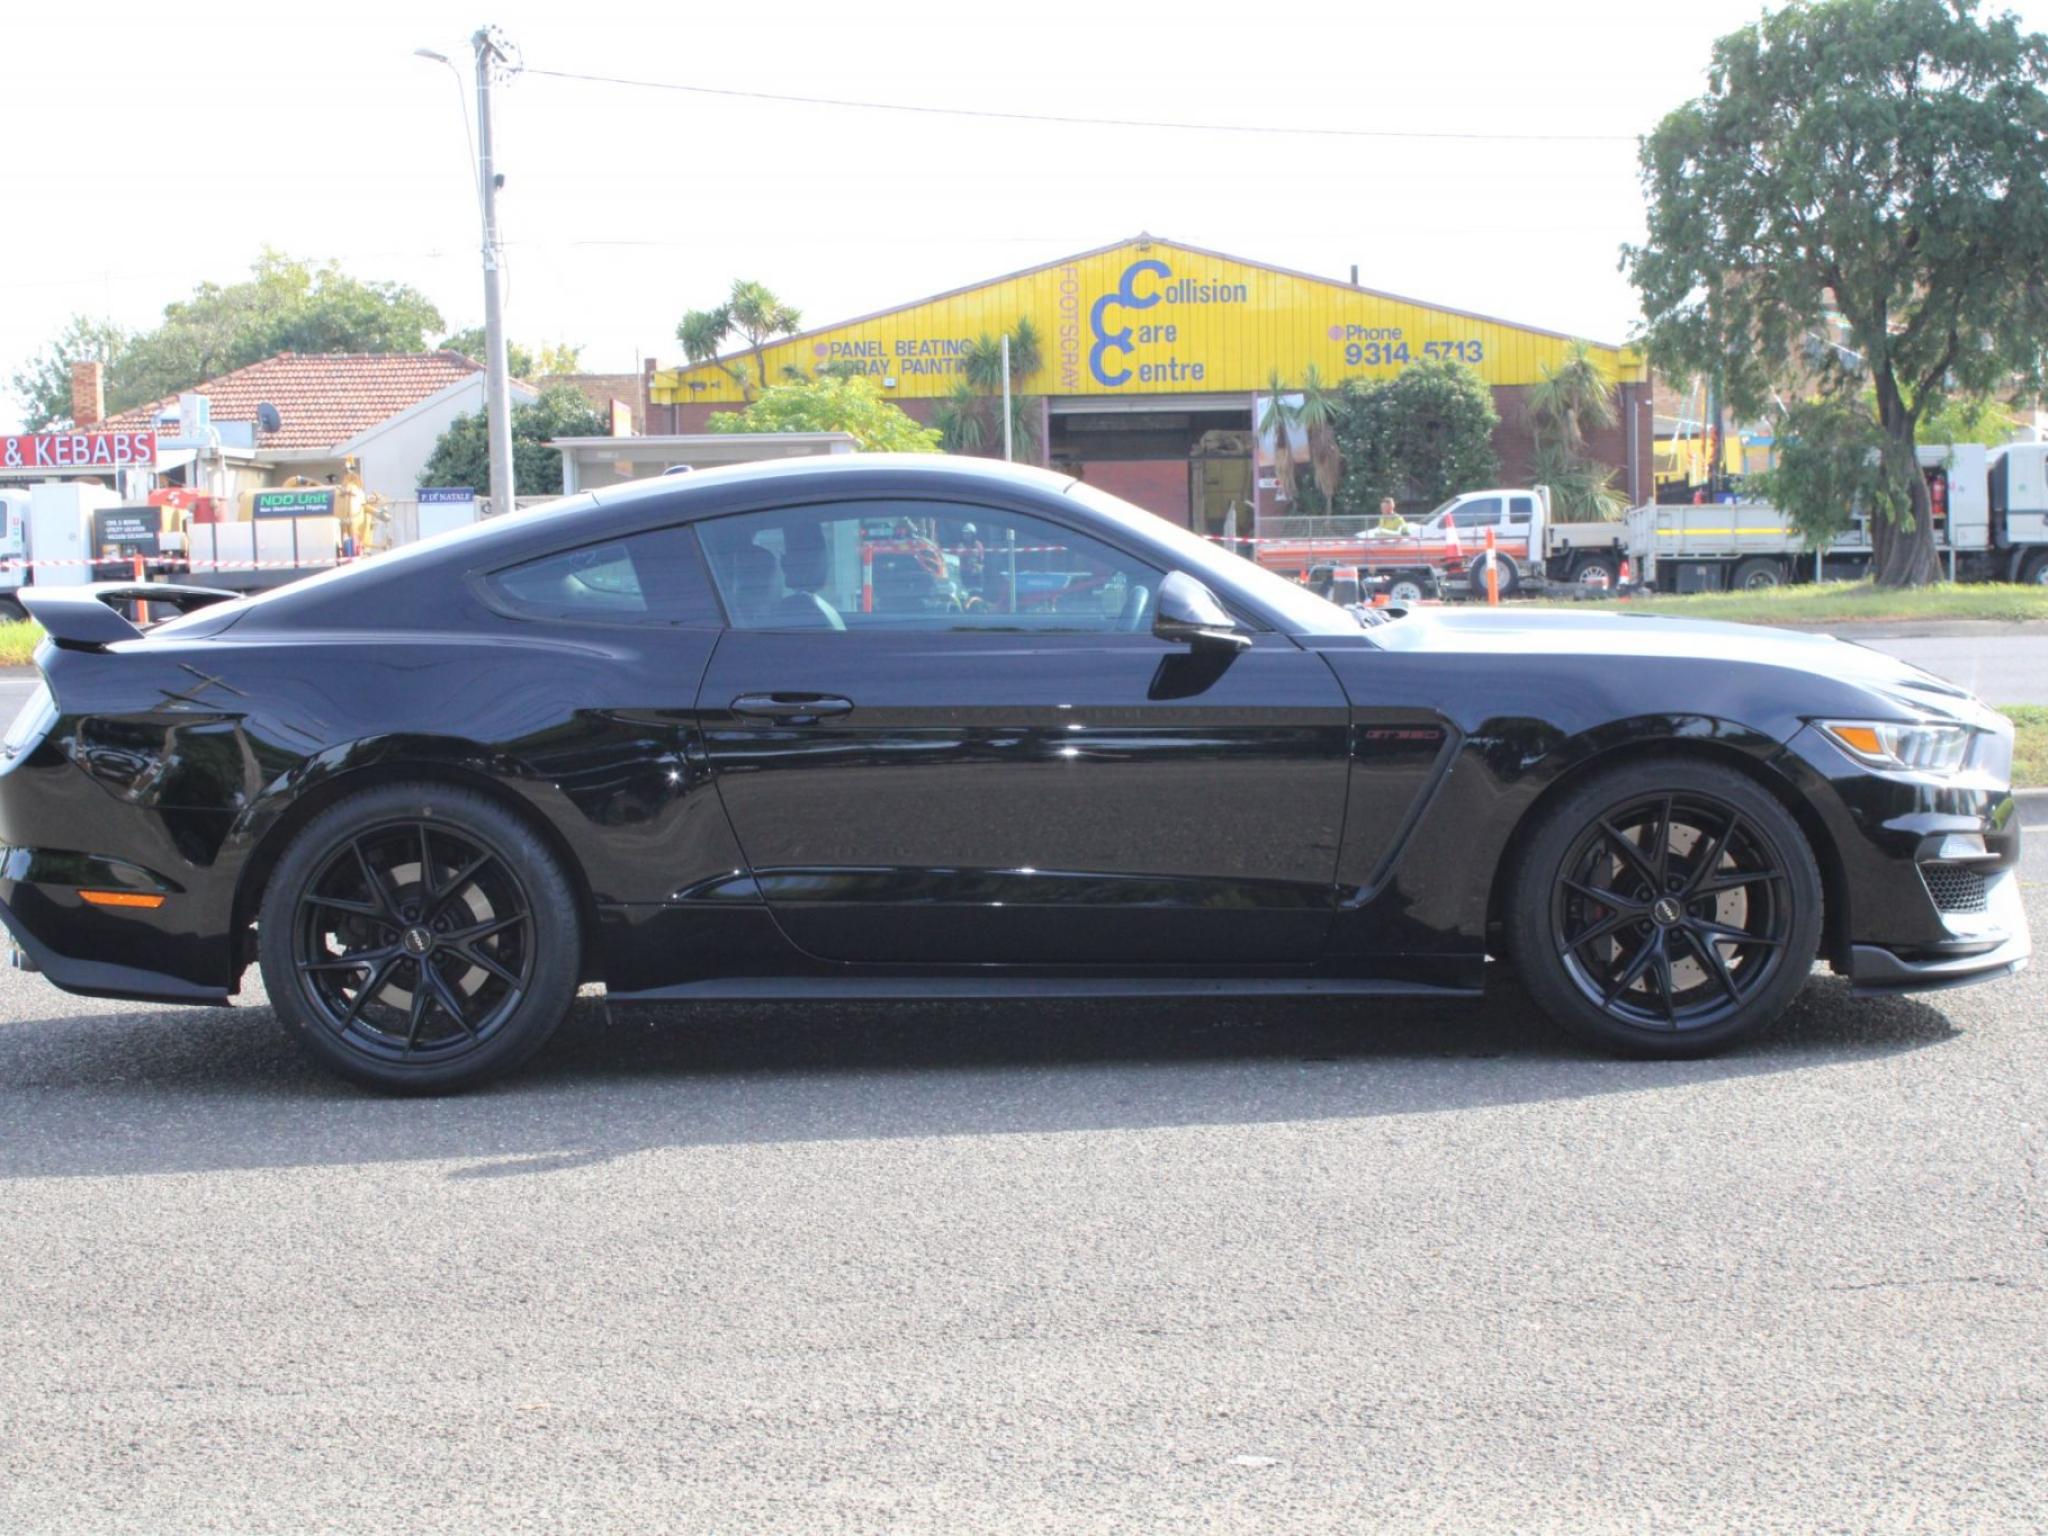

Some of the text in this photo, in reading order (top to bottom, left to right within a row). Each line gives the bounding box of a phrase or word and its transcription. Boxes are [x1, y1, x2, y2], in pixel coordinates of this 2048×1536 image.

[1119, 259, 1247, 309] Collision
[1059, 266, 1080, 390] FOOTSCRAY
[1346, 325, 1402, 341] Phone
[830, 340, 887, 357] PANEL
[1089, 338, 1204, 387] Centre
[4, 434, 152, 467] & KEBABS
[298, 492, 328, 504] Unit
